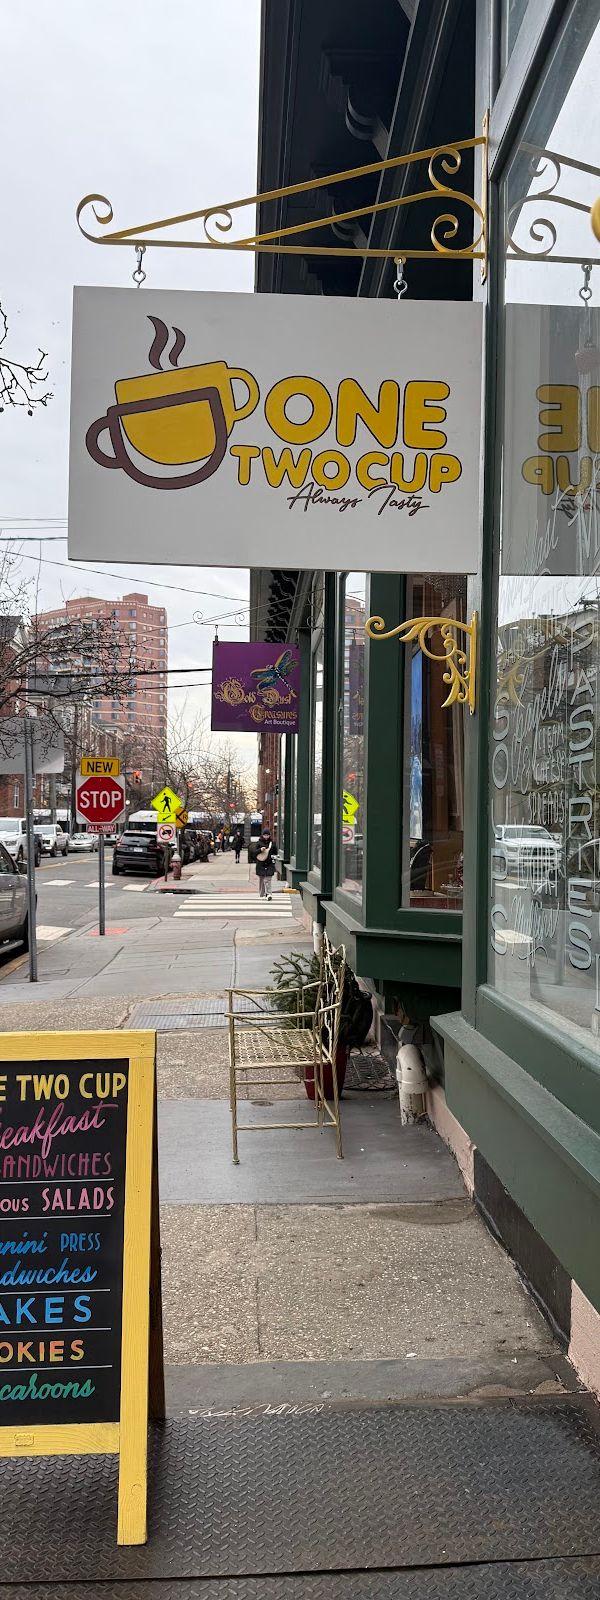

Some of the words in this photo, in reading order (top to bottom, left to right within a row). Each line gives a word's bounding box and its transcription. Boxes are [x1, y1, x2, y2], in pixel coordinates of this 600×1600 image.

[264, 375, 450, 449] ONE
[230, 445, 351, 490] TWO
[355, 451, 462, 493] CUP
[287, 481, 362, 512] Always
[368, 485, 430, 516] Tasty
[86, 761, 114, 773] NEW
[80, 791, 122, 808] STOP
[87, 824, 115, 833] ALL-WAY
[490, 695, 510, 956] SOUPS
[16, 1073, 70, 1101] TWO
[79, 1072, 127, 1099] CUP
[0, 1100, 119, 1159] eakfast
[0, 1152, 112, 1179] ANDWICHES
[42, 1186, 115, 1212] SALADS
[60, 1232, 101, 1252] PRESS
[0, 1339, 85, 1363] OKIES
